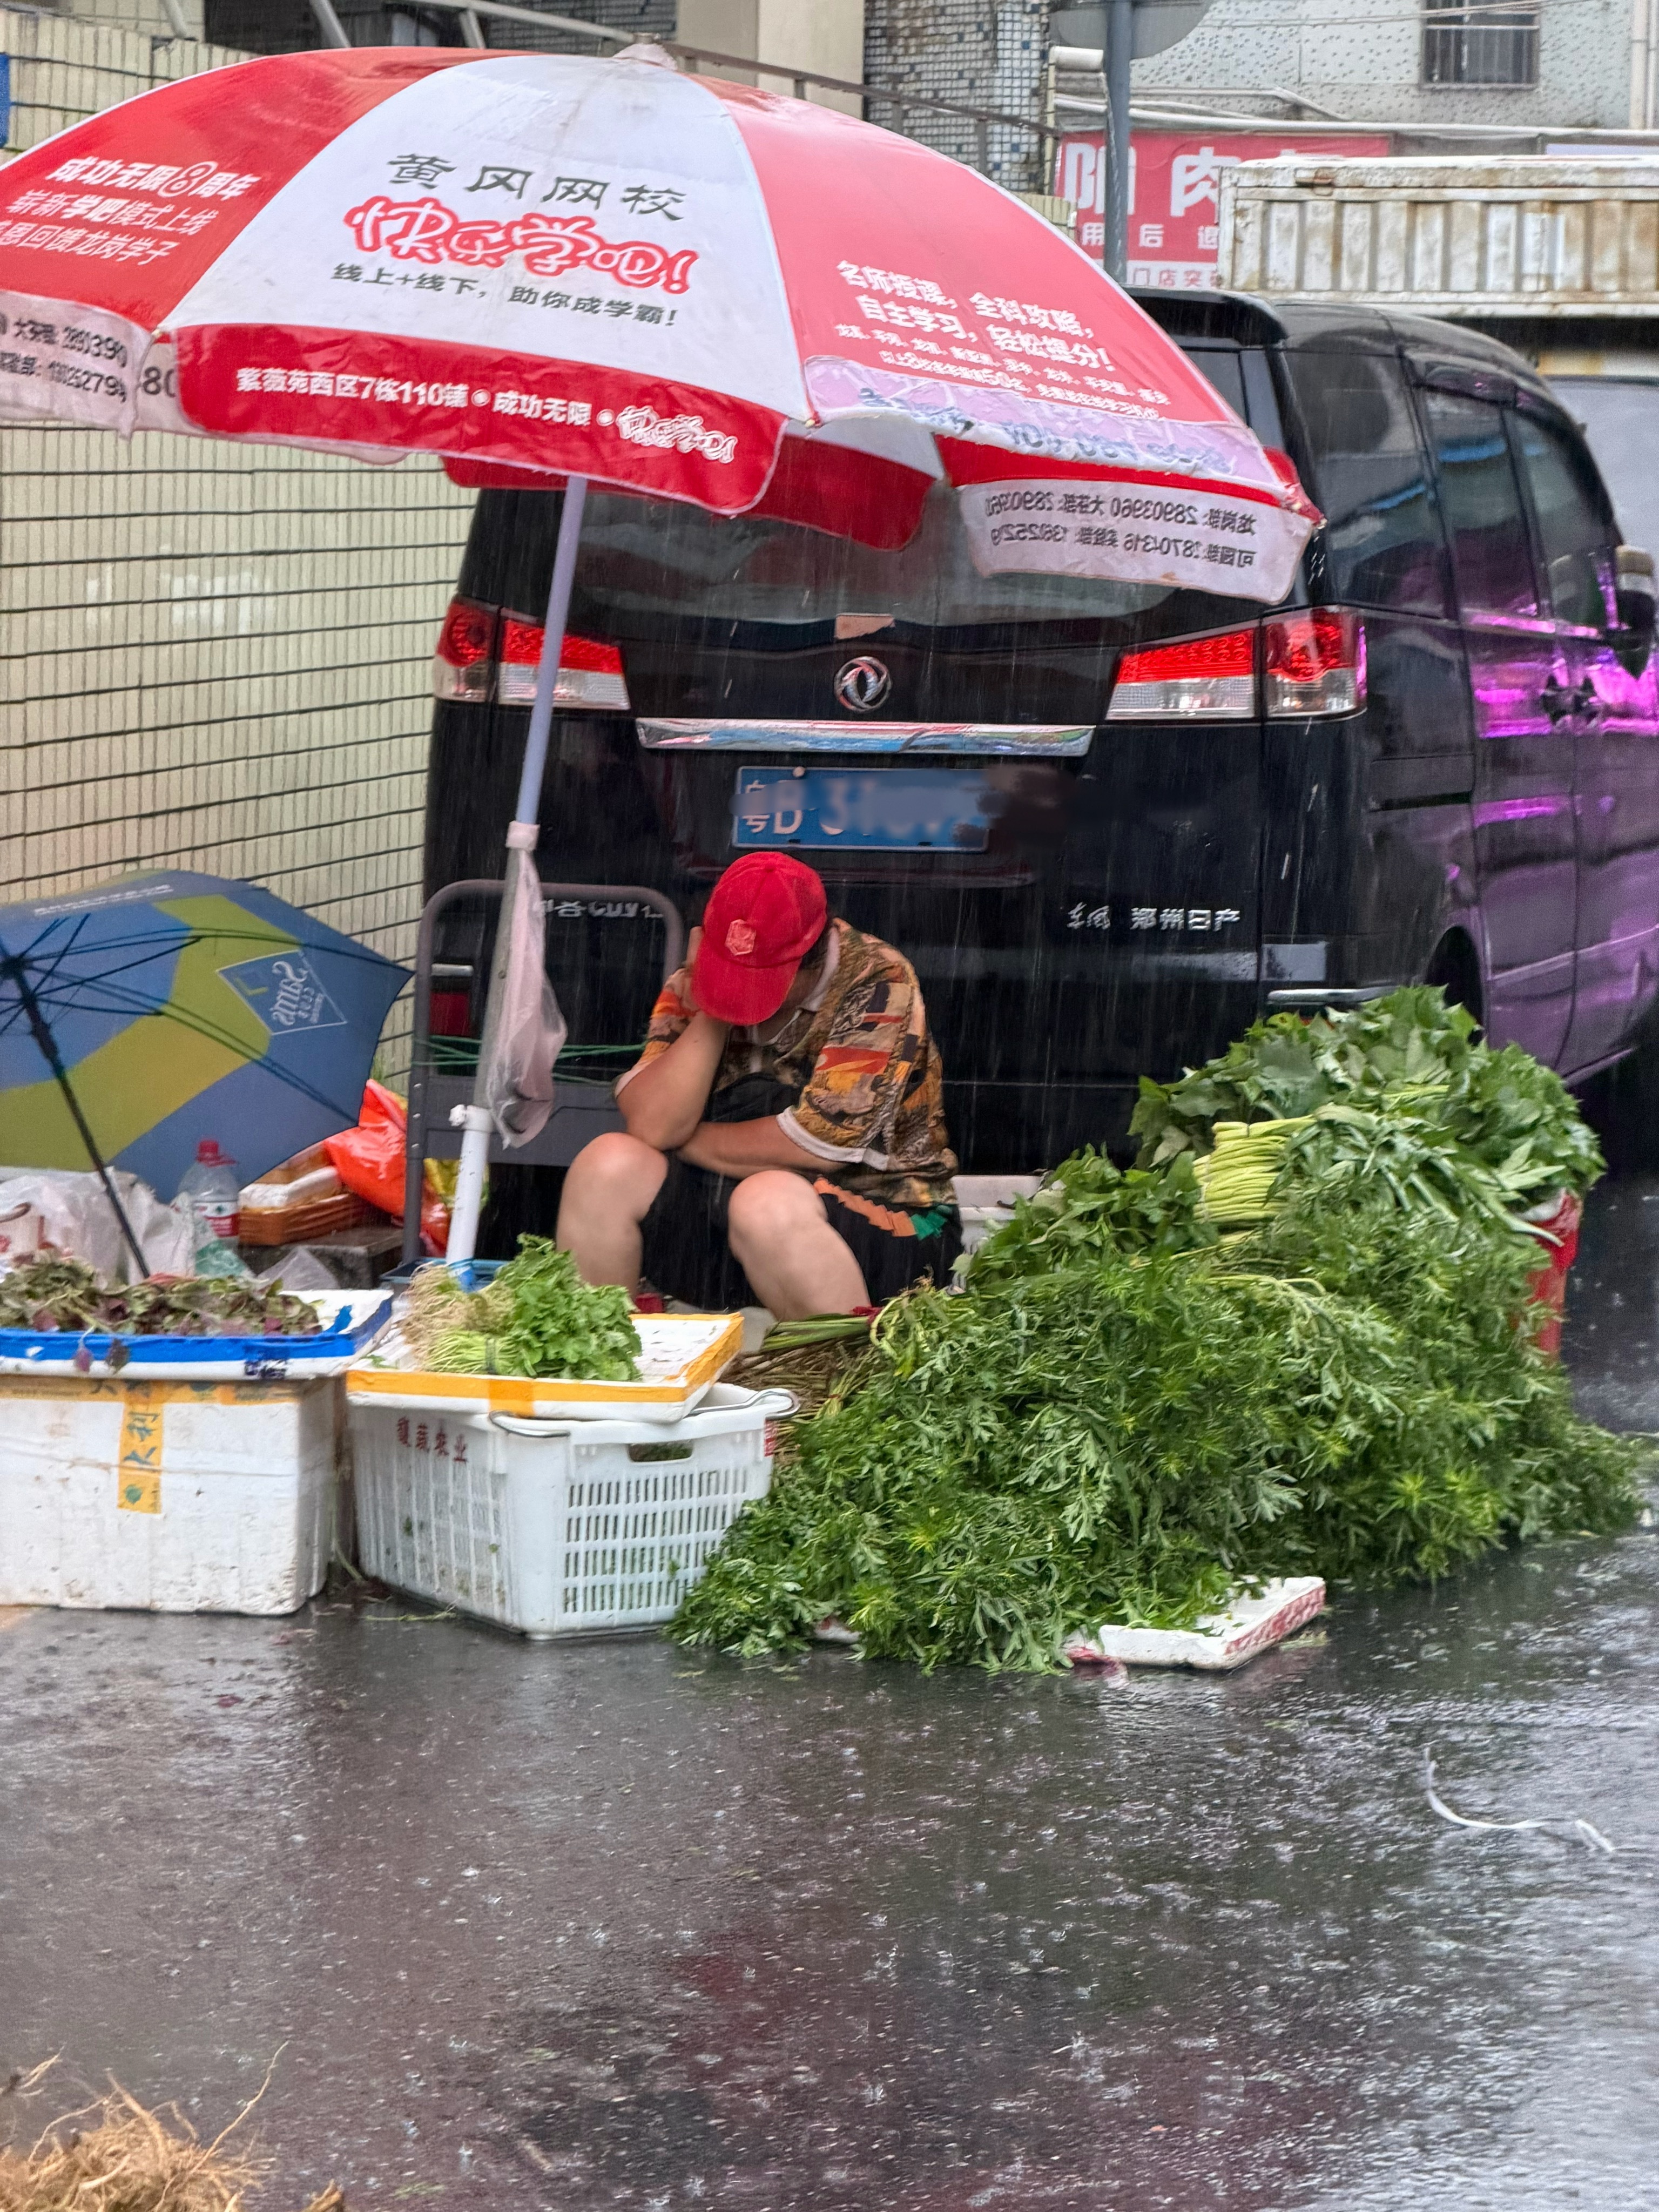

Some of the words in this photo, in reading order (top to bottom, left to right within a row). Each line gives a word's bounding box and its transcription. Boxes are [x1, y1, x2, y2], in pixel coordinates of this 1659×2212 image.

[45, 156, 261, 200] 成功无限8周年
[387, 153, 687, 220] 黄冈网校
[6, 189, 219, 235] 崭新学吧模式上线
[493, 390, 592, 427] 成功无限
[1130, 907, 1240, 932] 郑州日产
